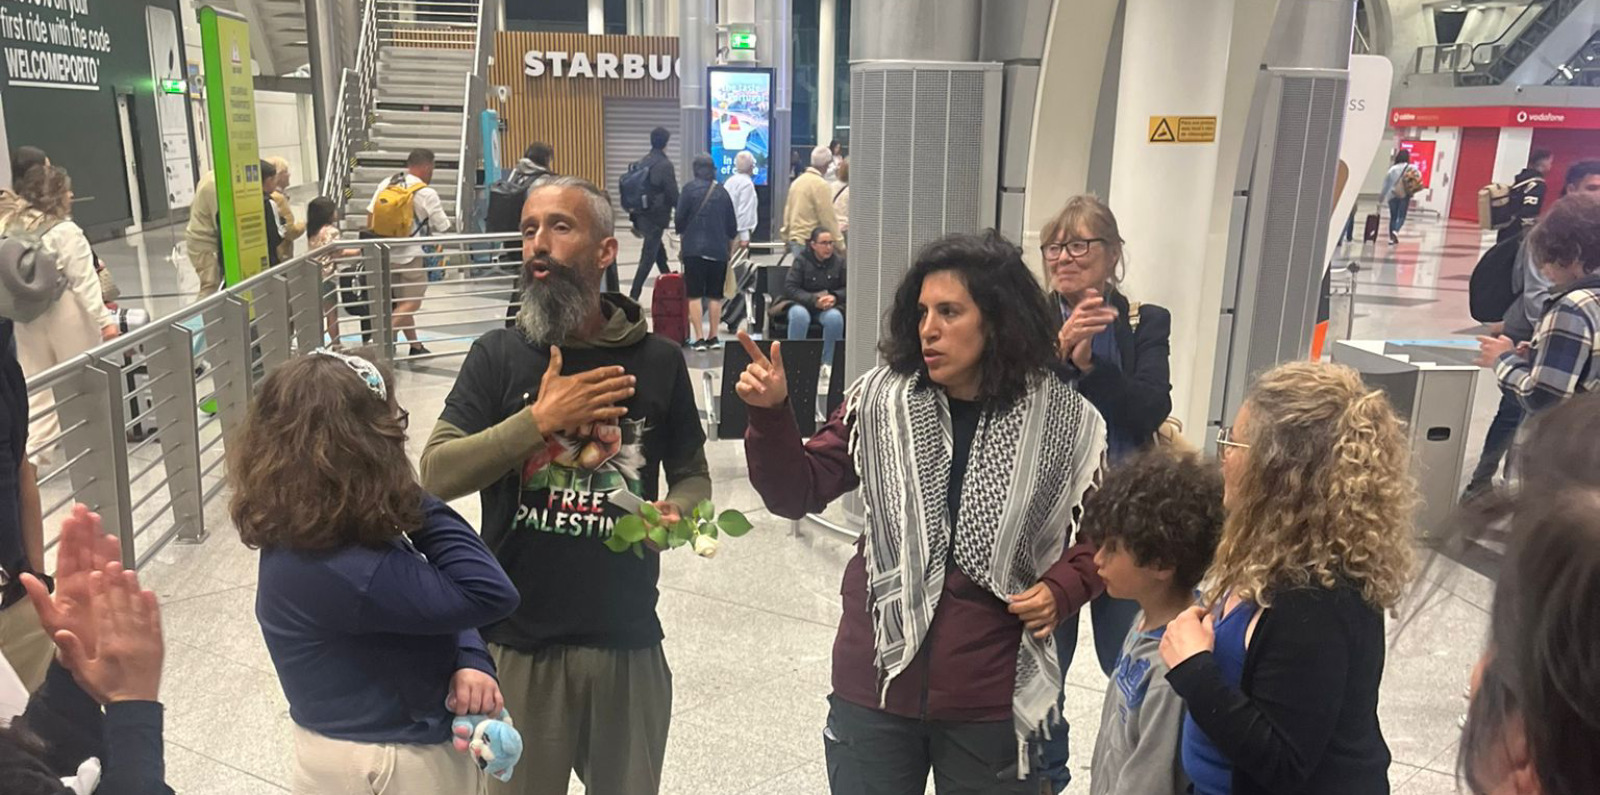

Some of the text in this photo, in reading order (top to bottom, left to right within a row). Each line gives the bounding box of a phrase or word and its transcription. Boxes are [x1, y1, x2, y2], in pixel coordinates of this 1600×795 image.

[0, 6, 111, 53] first ride with the code
[524, 50, 680, 80] STARBU
[721, 165, 731, 175] of
[547, 486, 605, 513] FREE
